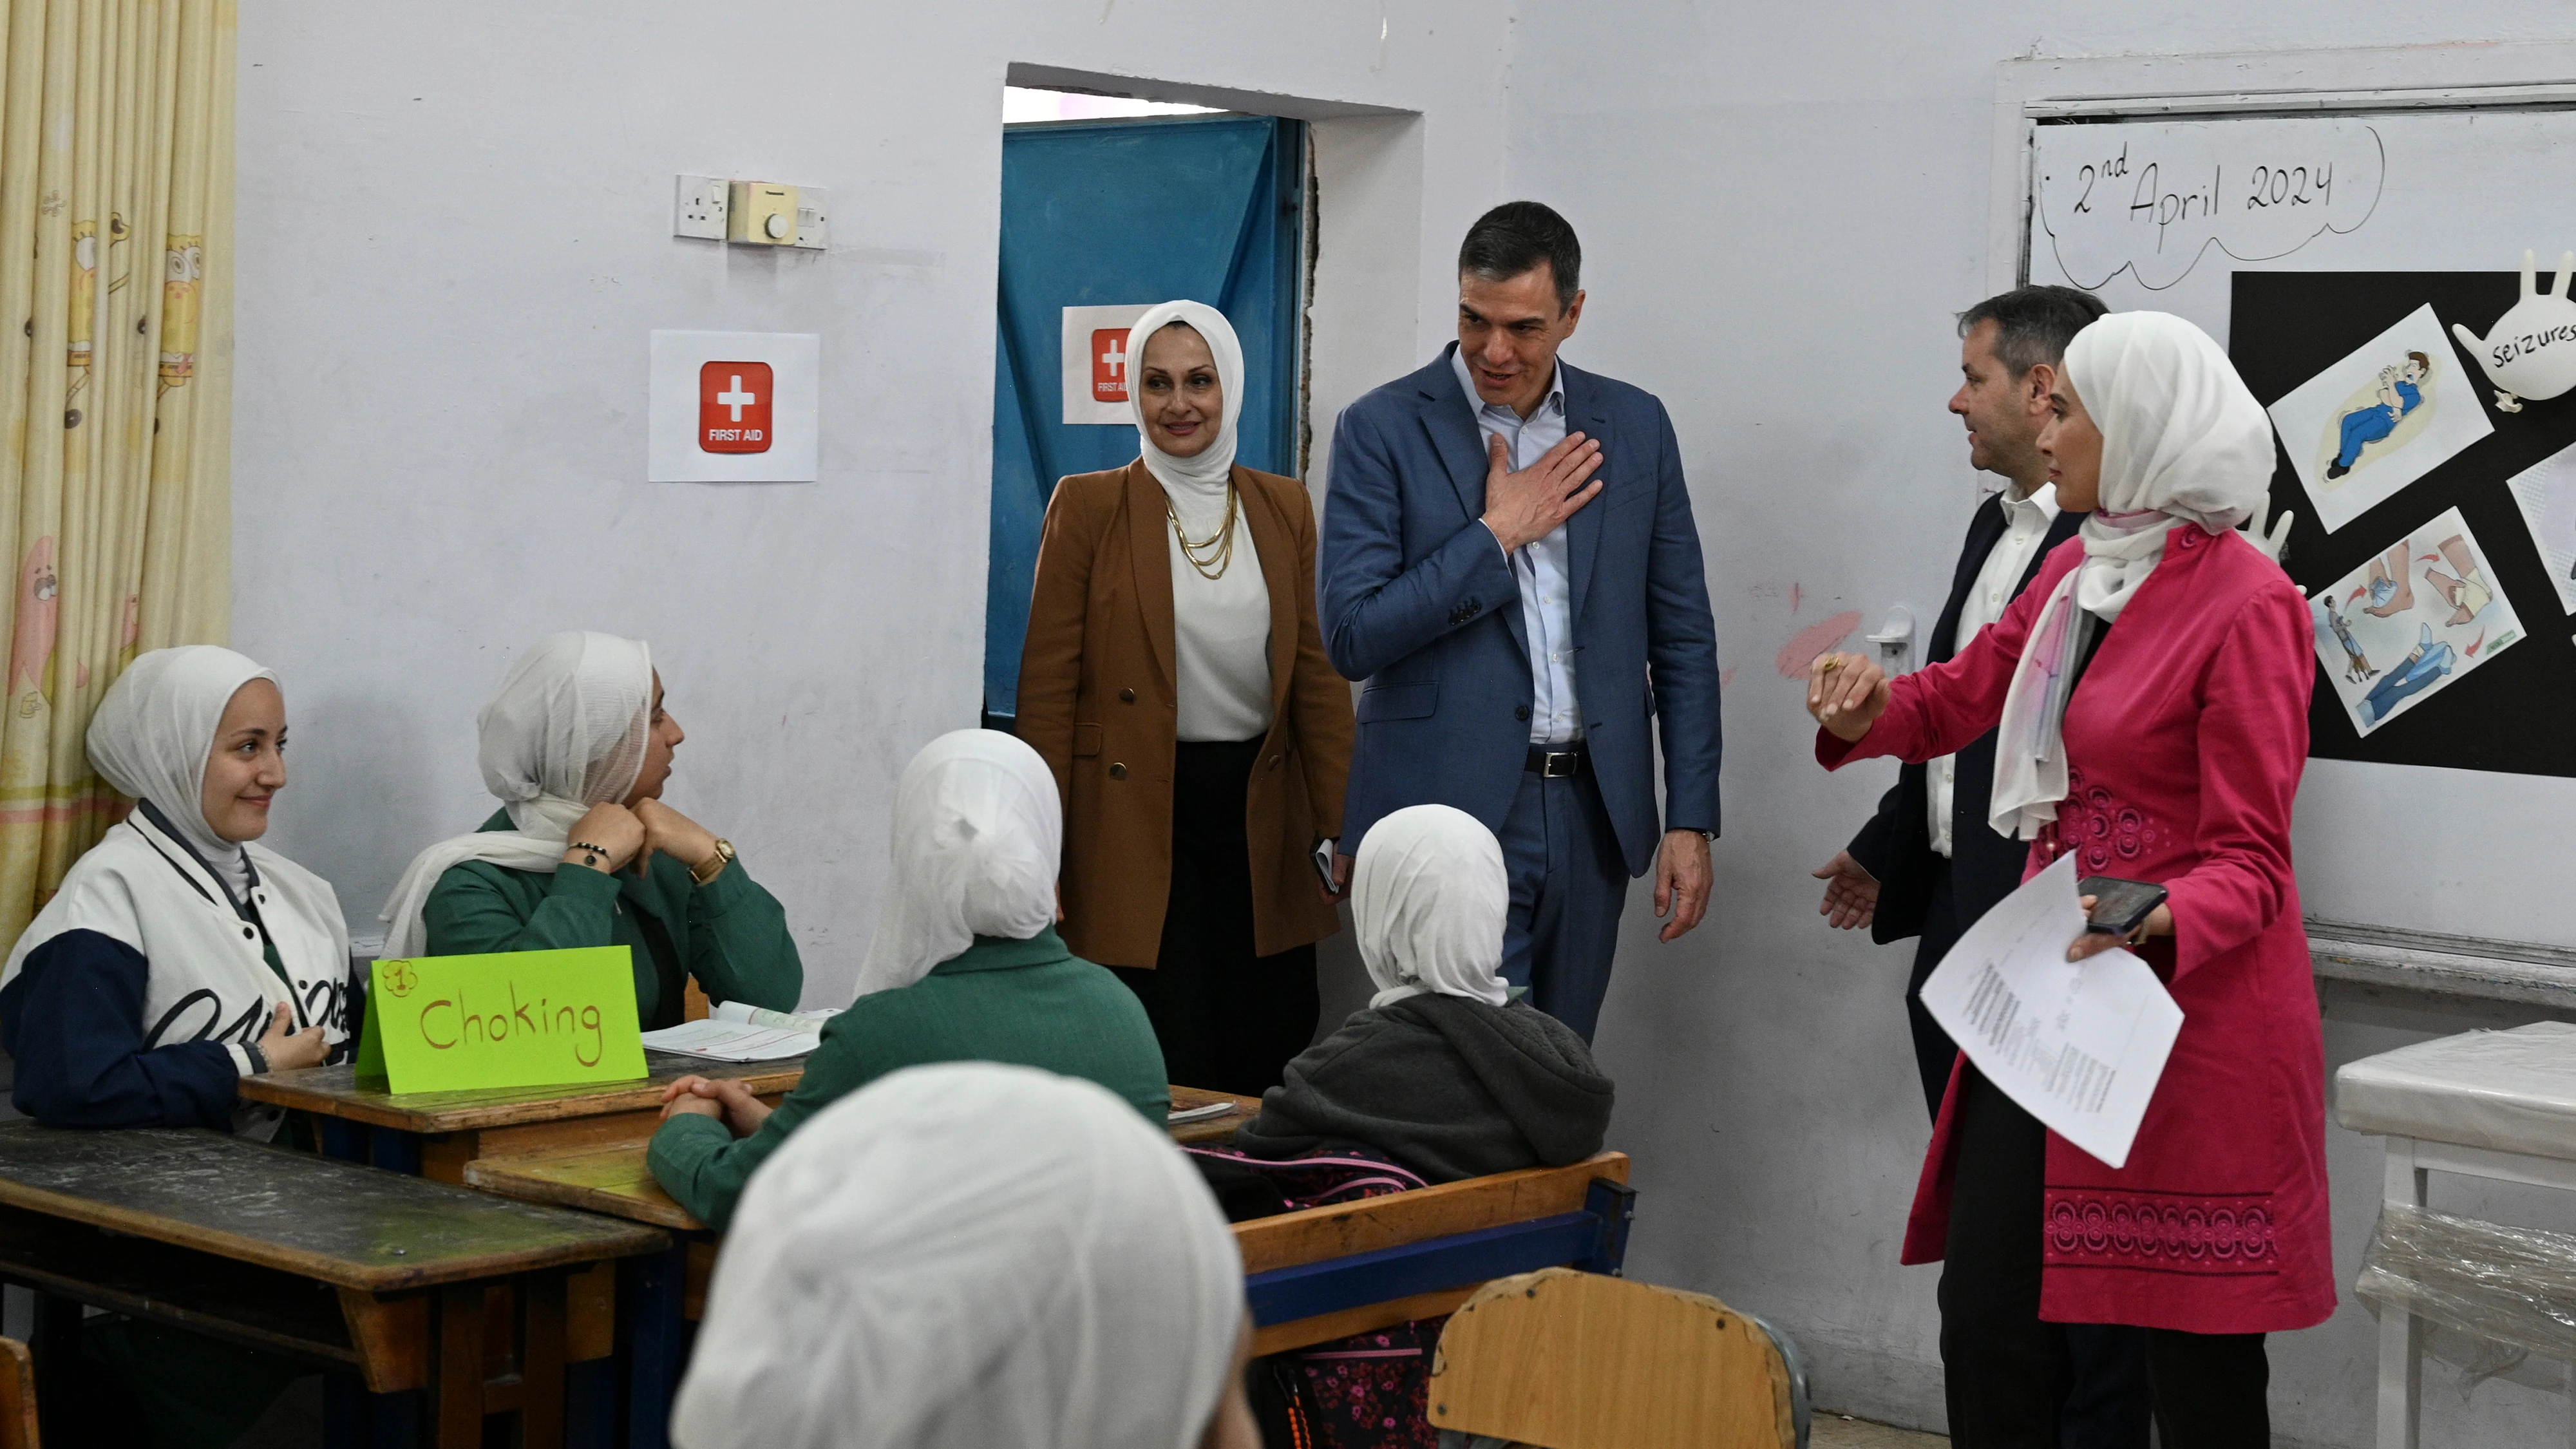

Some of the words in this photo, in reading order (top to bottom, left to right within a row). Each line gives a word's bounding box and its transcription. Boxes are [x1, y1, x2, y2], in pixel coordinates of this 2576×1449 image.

[2074, 140, 2128, 213] 2nd
[2130, 162, 2221, 254] April
[2248, 161, 2333, 211] 2024
[1097, 382, 1118, 392] FIRST
[709, 428, 742, 441] FIRST
[743, 429, 763, 441] AID
[420, 980, 603, 1068] Choking
